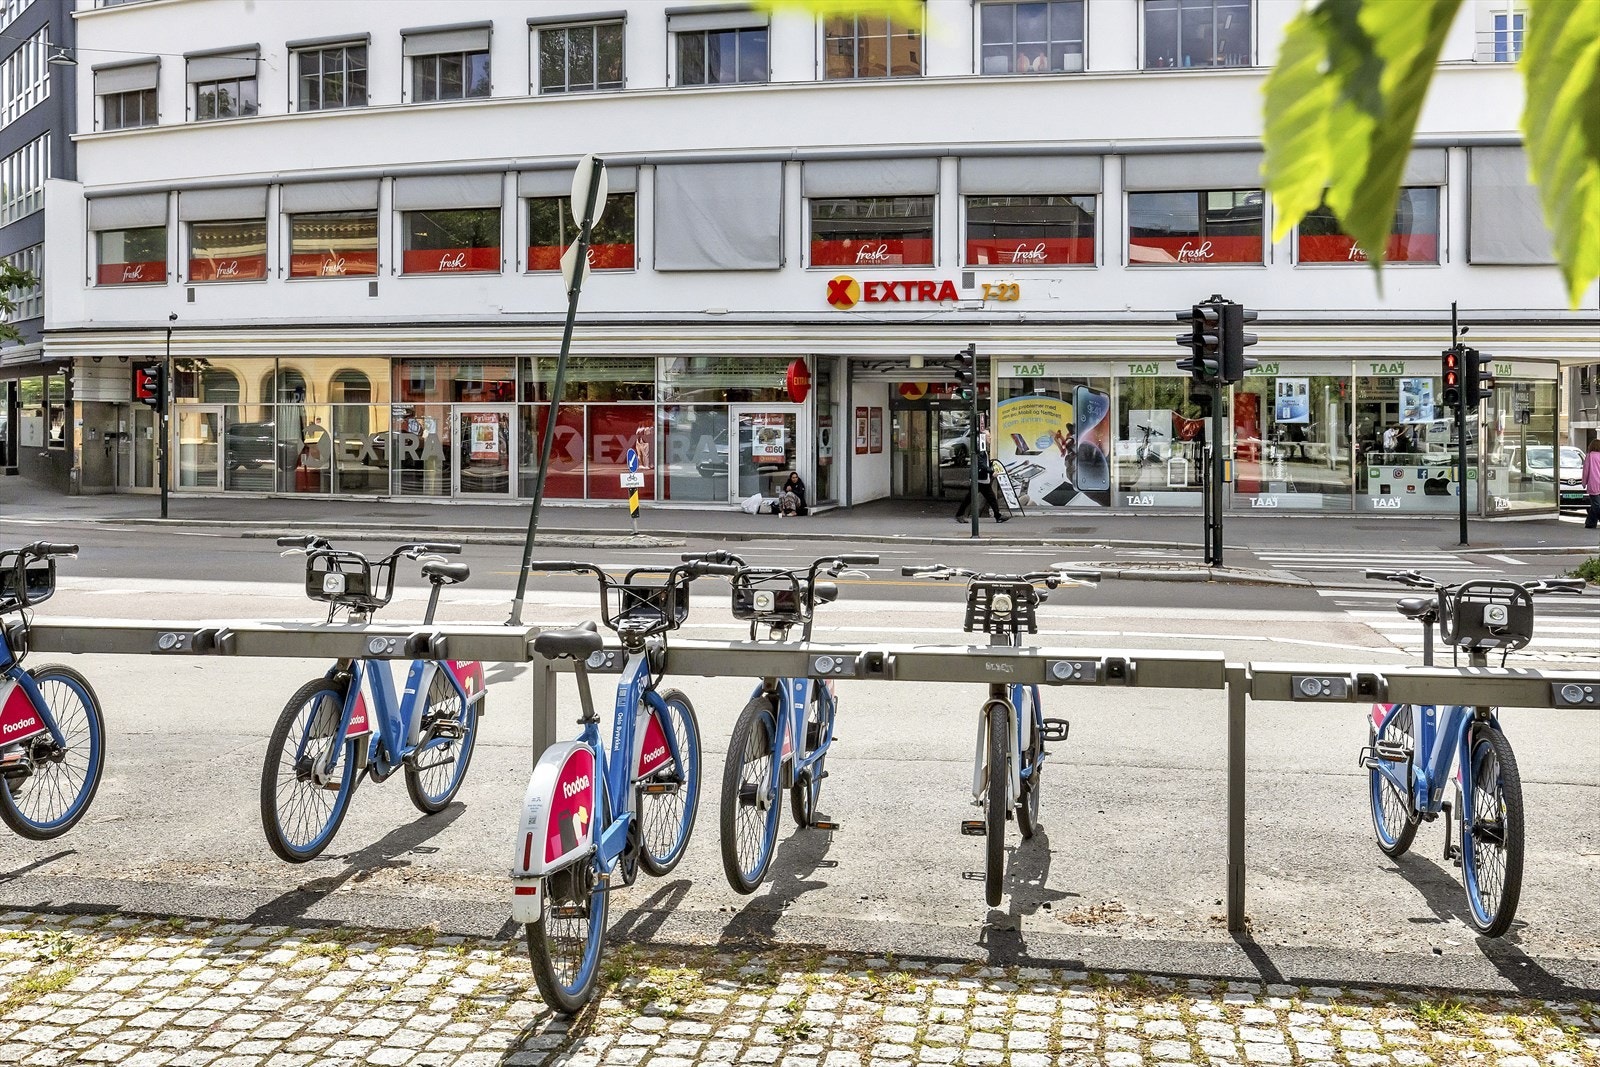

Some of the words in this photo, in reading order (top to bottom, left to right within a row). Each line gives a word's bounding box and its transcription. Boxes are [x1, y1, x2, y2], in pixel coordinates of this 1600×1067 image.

[439, 252, 467, 271] fresh
[855, 243, 890, 264] fresh
[1012, 243, 1047, 263] fresh
[1178, 241, 1214, 263] fresh
[123, 265, 143, 282] fresh
[216, 260, 239, 278] fresh
[322, 257, 347, 276] fresh
[863, 280, 959, 302] EXTRA
[981, 283, 1020, 302] 7-23
[1013, 363, 1046, 376] TAAJ
[1128, 362, 1160, 375] TAAJ
[1250, 362, 1280, 376] AAJ
[1370, 361, 1405, 375] TAAJ
[1569, 689, 1578, 699] 5
[3, 716, 36, 735] foodora
[643, 745, 666, 764] foodora
[563, 774, 590, 799] foodora
